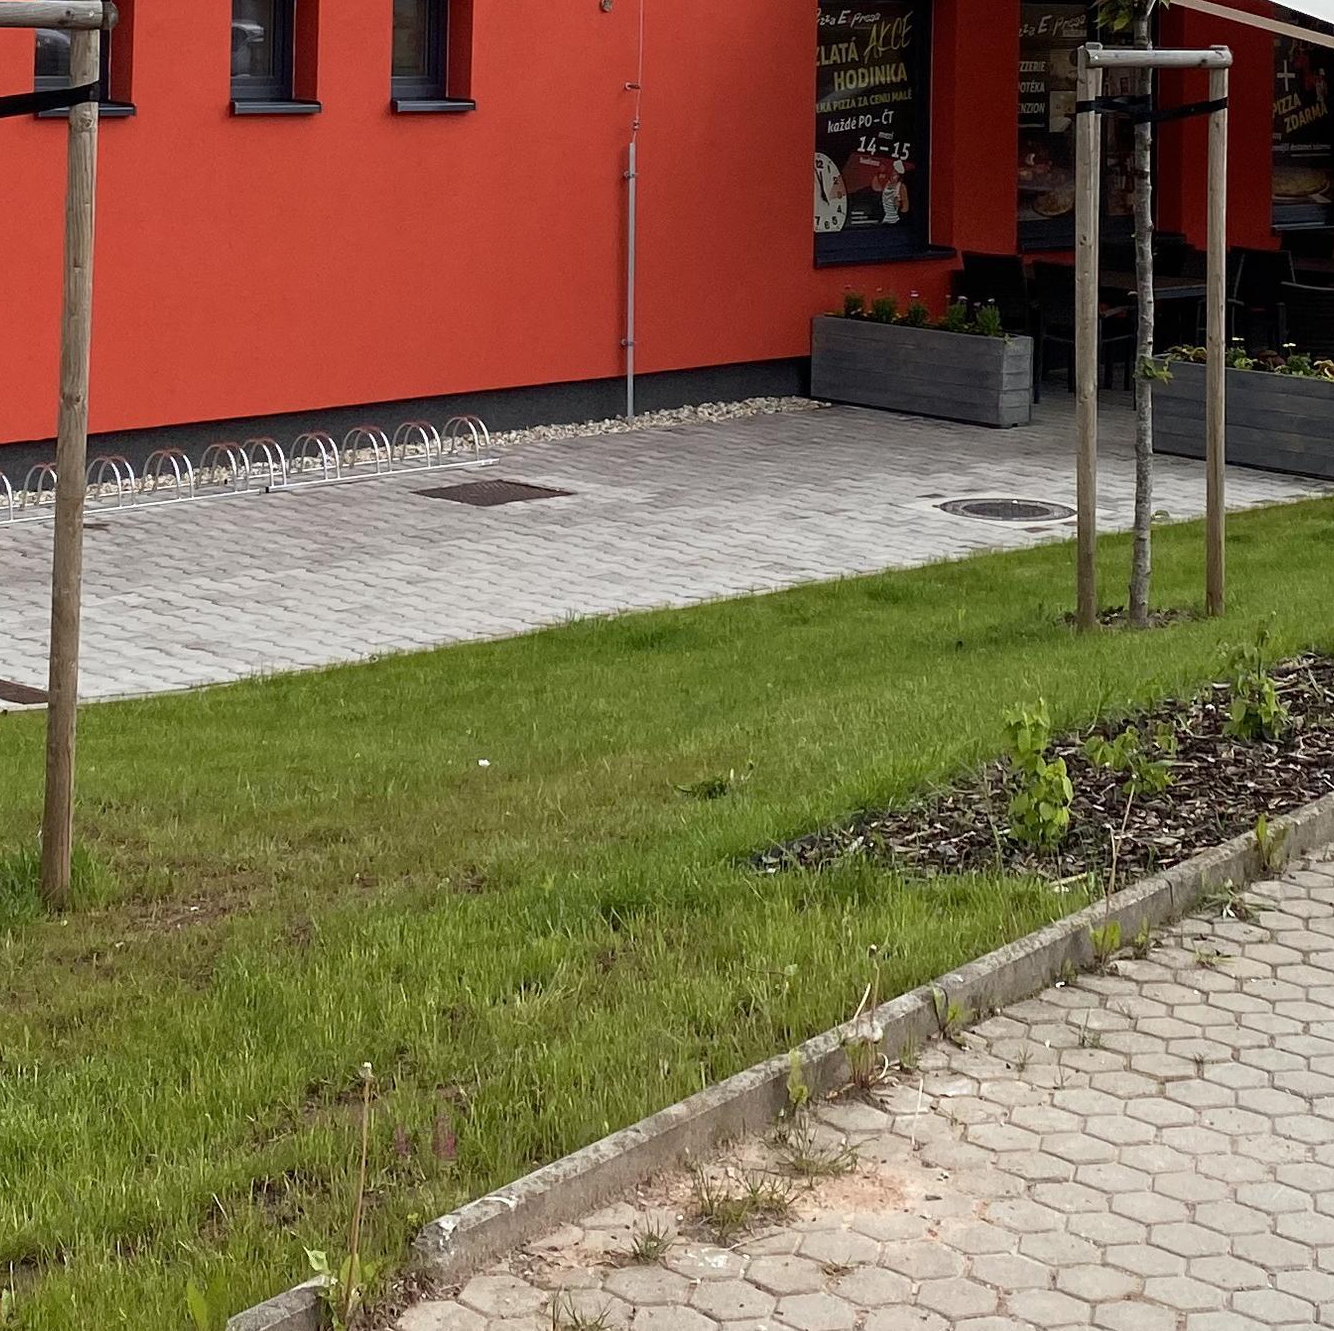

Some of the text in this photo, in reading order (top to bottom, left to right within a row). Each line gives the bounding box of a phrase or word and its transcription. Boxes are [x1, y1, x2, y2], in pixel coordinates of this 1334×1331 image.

[863, 11, 914, 64] AKCE
[834, 62, 908, 91] HODINKA
[1272, 91, 1302, 118] PIZZA
[1283, 102, 1328, 134] ZDARMA
[827, 116, 856, 133] každé
[857, 135, 877, 155] 14
[891, 142, 911, 160] 15
